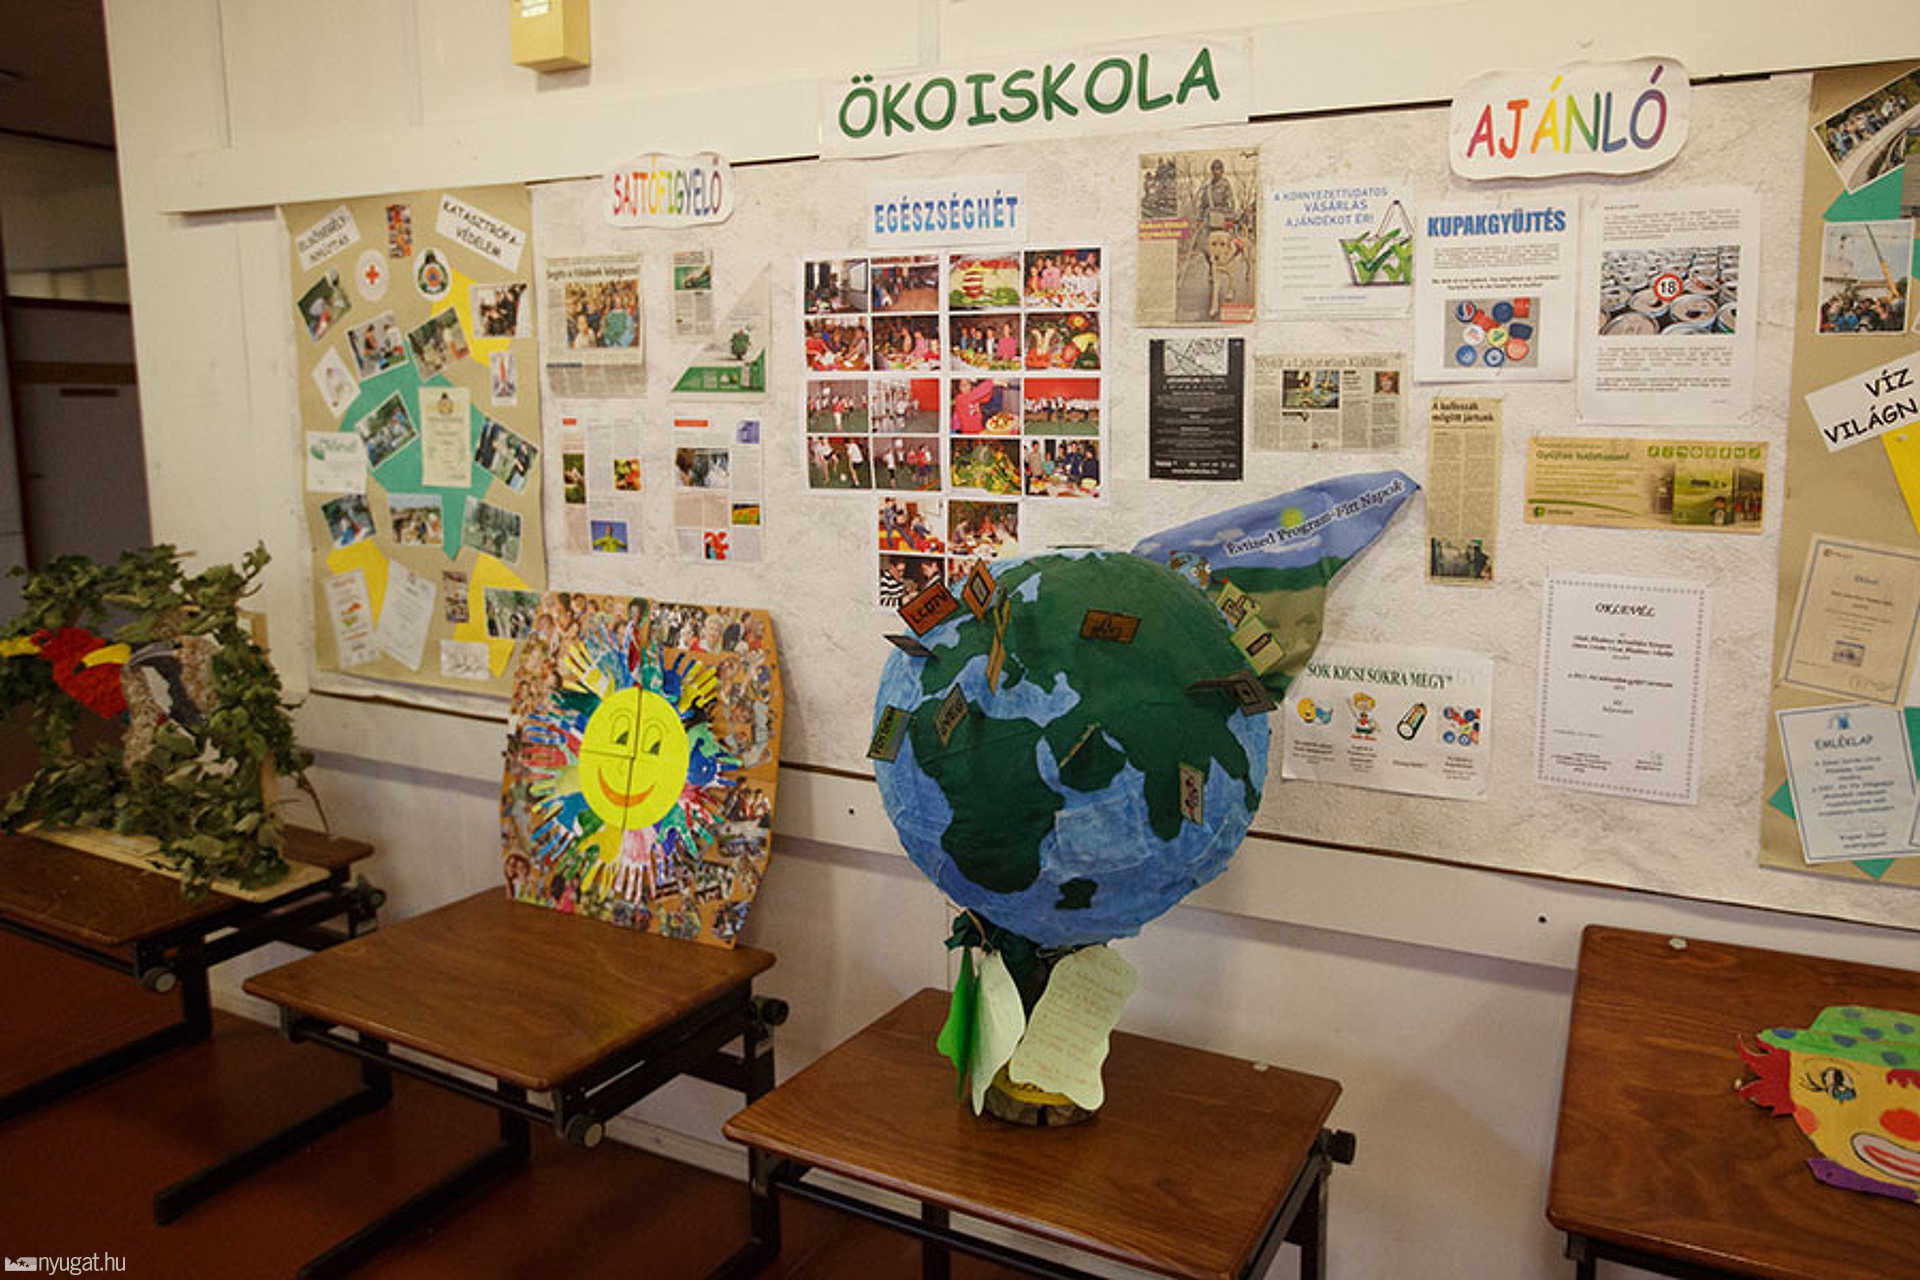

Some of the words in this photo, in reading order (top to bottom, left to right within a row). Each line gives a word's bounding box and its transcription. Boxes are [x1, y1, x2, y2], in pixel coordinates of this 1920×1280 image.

[838, 47, 1221, 138] ÖKOISKOLA
[1466, 65, 1668, 159] AJÁNLÓ
[874, 190, 1019, 234] EGÉSZSÉGHÉT
[1661, 281, 1677, 295] 18
[1865, 368, 1915, 397] VÍZ
